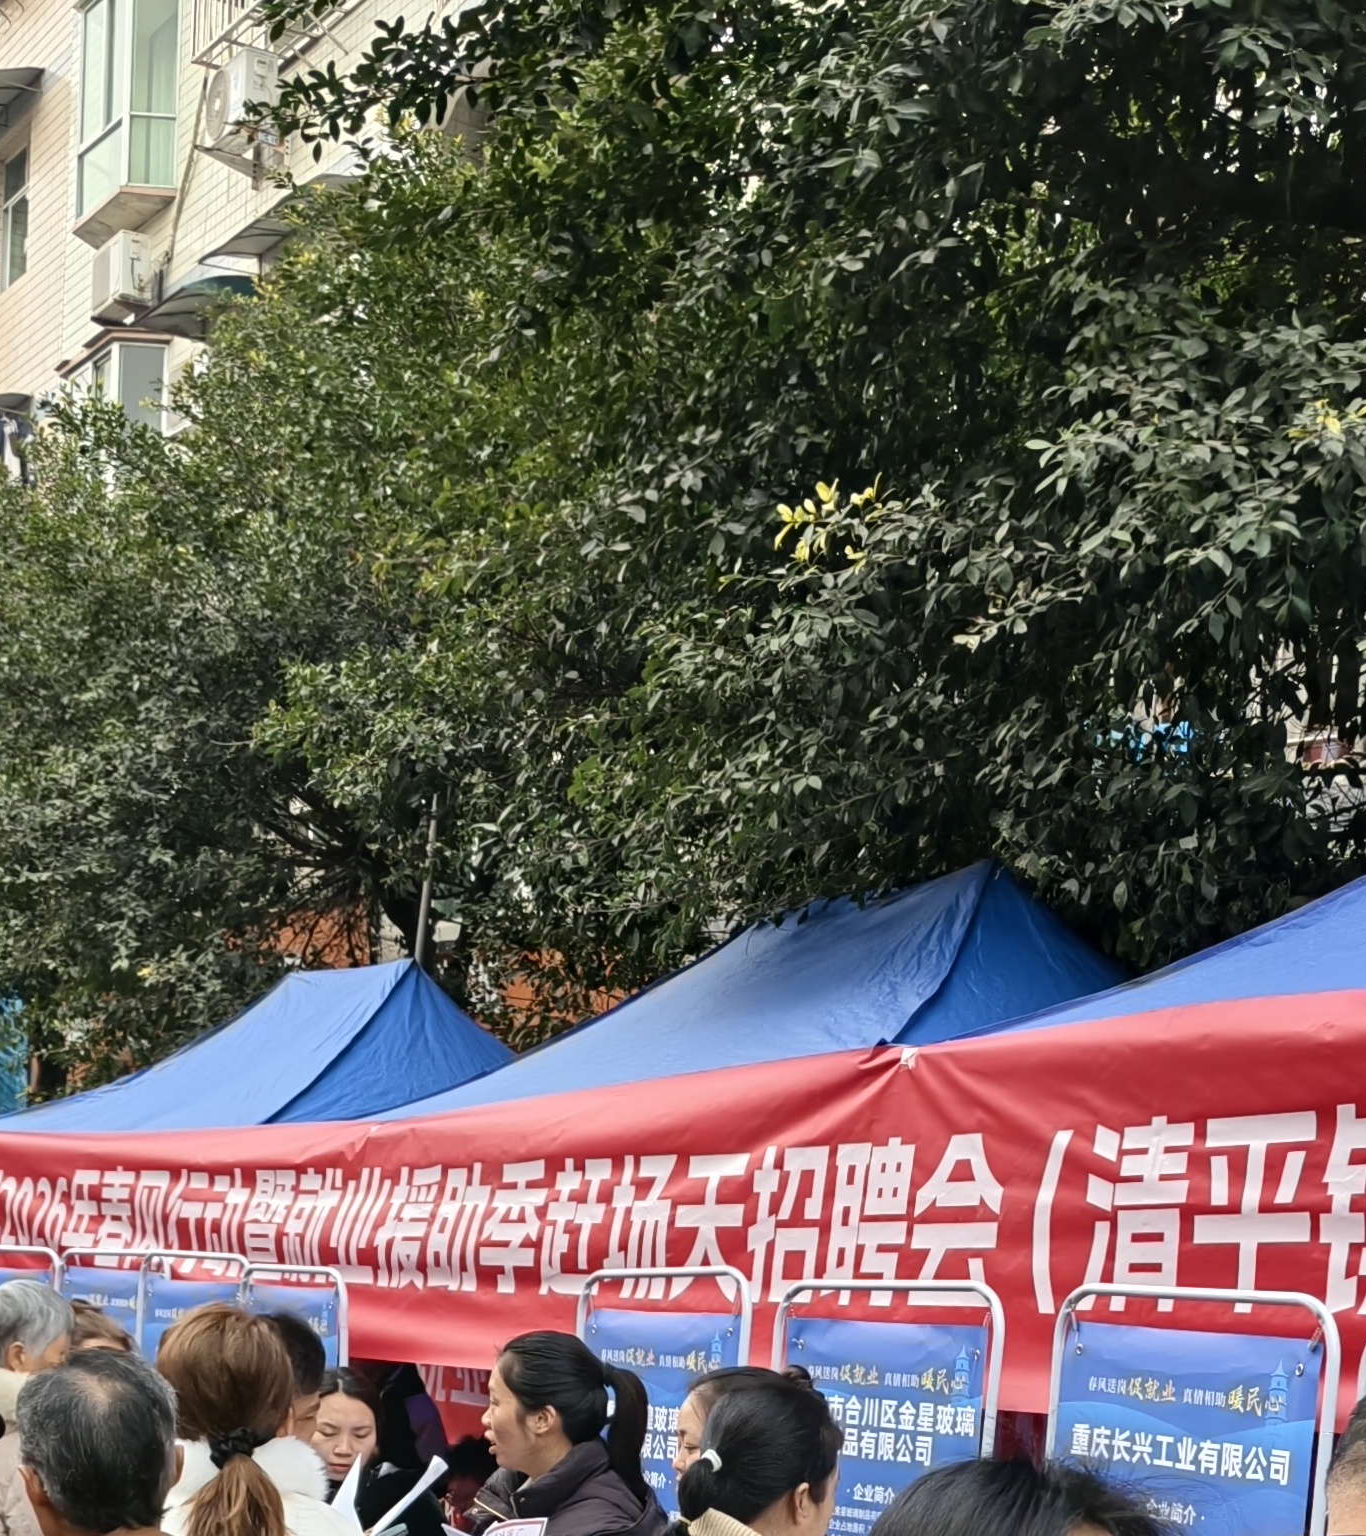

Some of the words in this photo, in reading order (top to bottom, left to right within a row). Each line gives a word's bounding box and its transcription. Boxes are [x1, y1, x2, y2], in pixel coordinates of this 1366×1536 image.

[1088, 1375, 1177, 1403] 春风送岗促就业
[1183, 1384, 1282, 1418] 真情相助暖民心
[1070, 1422, 1291, 1487] 重庆长兴工业有限公司
